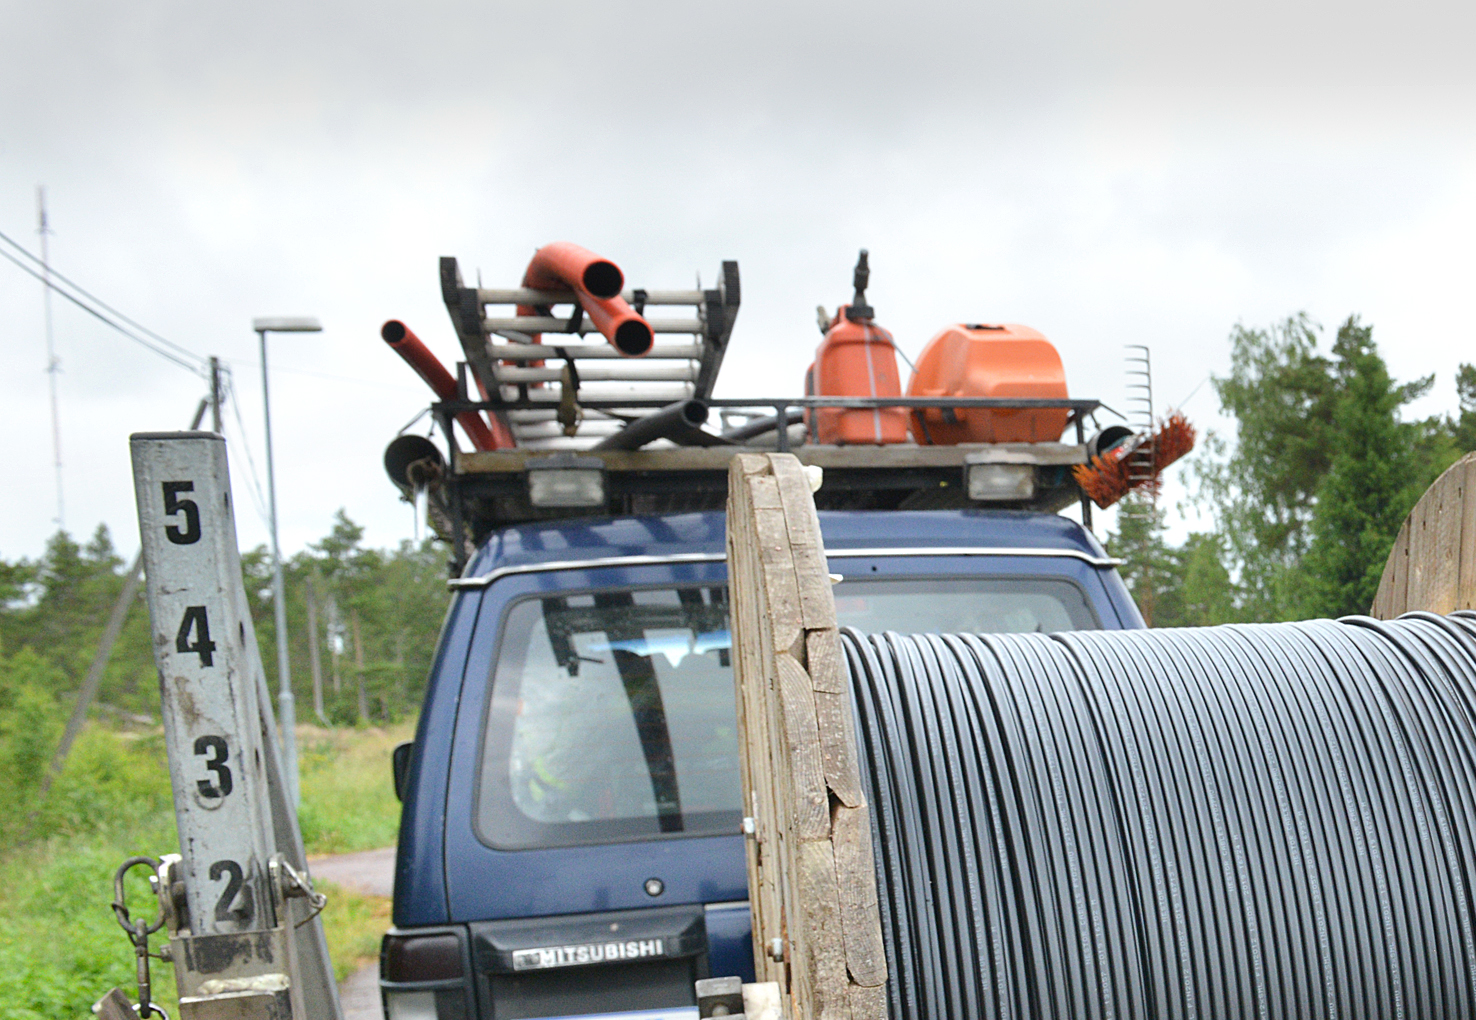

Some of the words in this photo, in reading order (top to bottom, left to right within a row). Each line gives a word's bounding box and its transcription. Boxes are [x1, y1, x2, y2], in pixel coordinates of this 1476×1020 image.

[162, 481, 201, 545] 5
[176, 606, 216, 667] 4
[193, 735, 233, 798] 3
[209, 860, 248, 922] 2
[540, 939, 663, 967] MITSUBISHI
